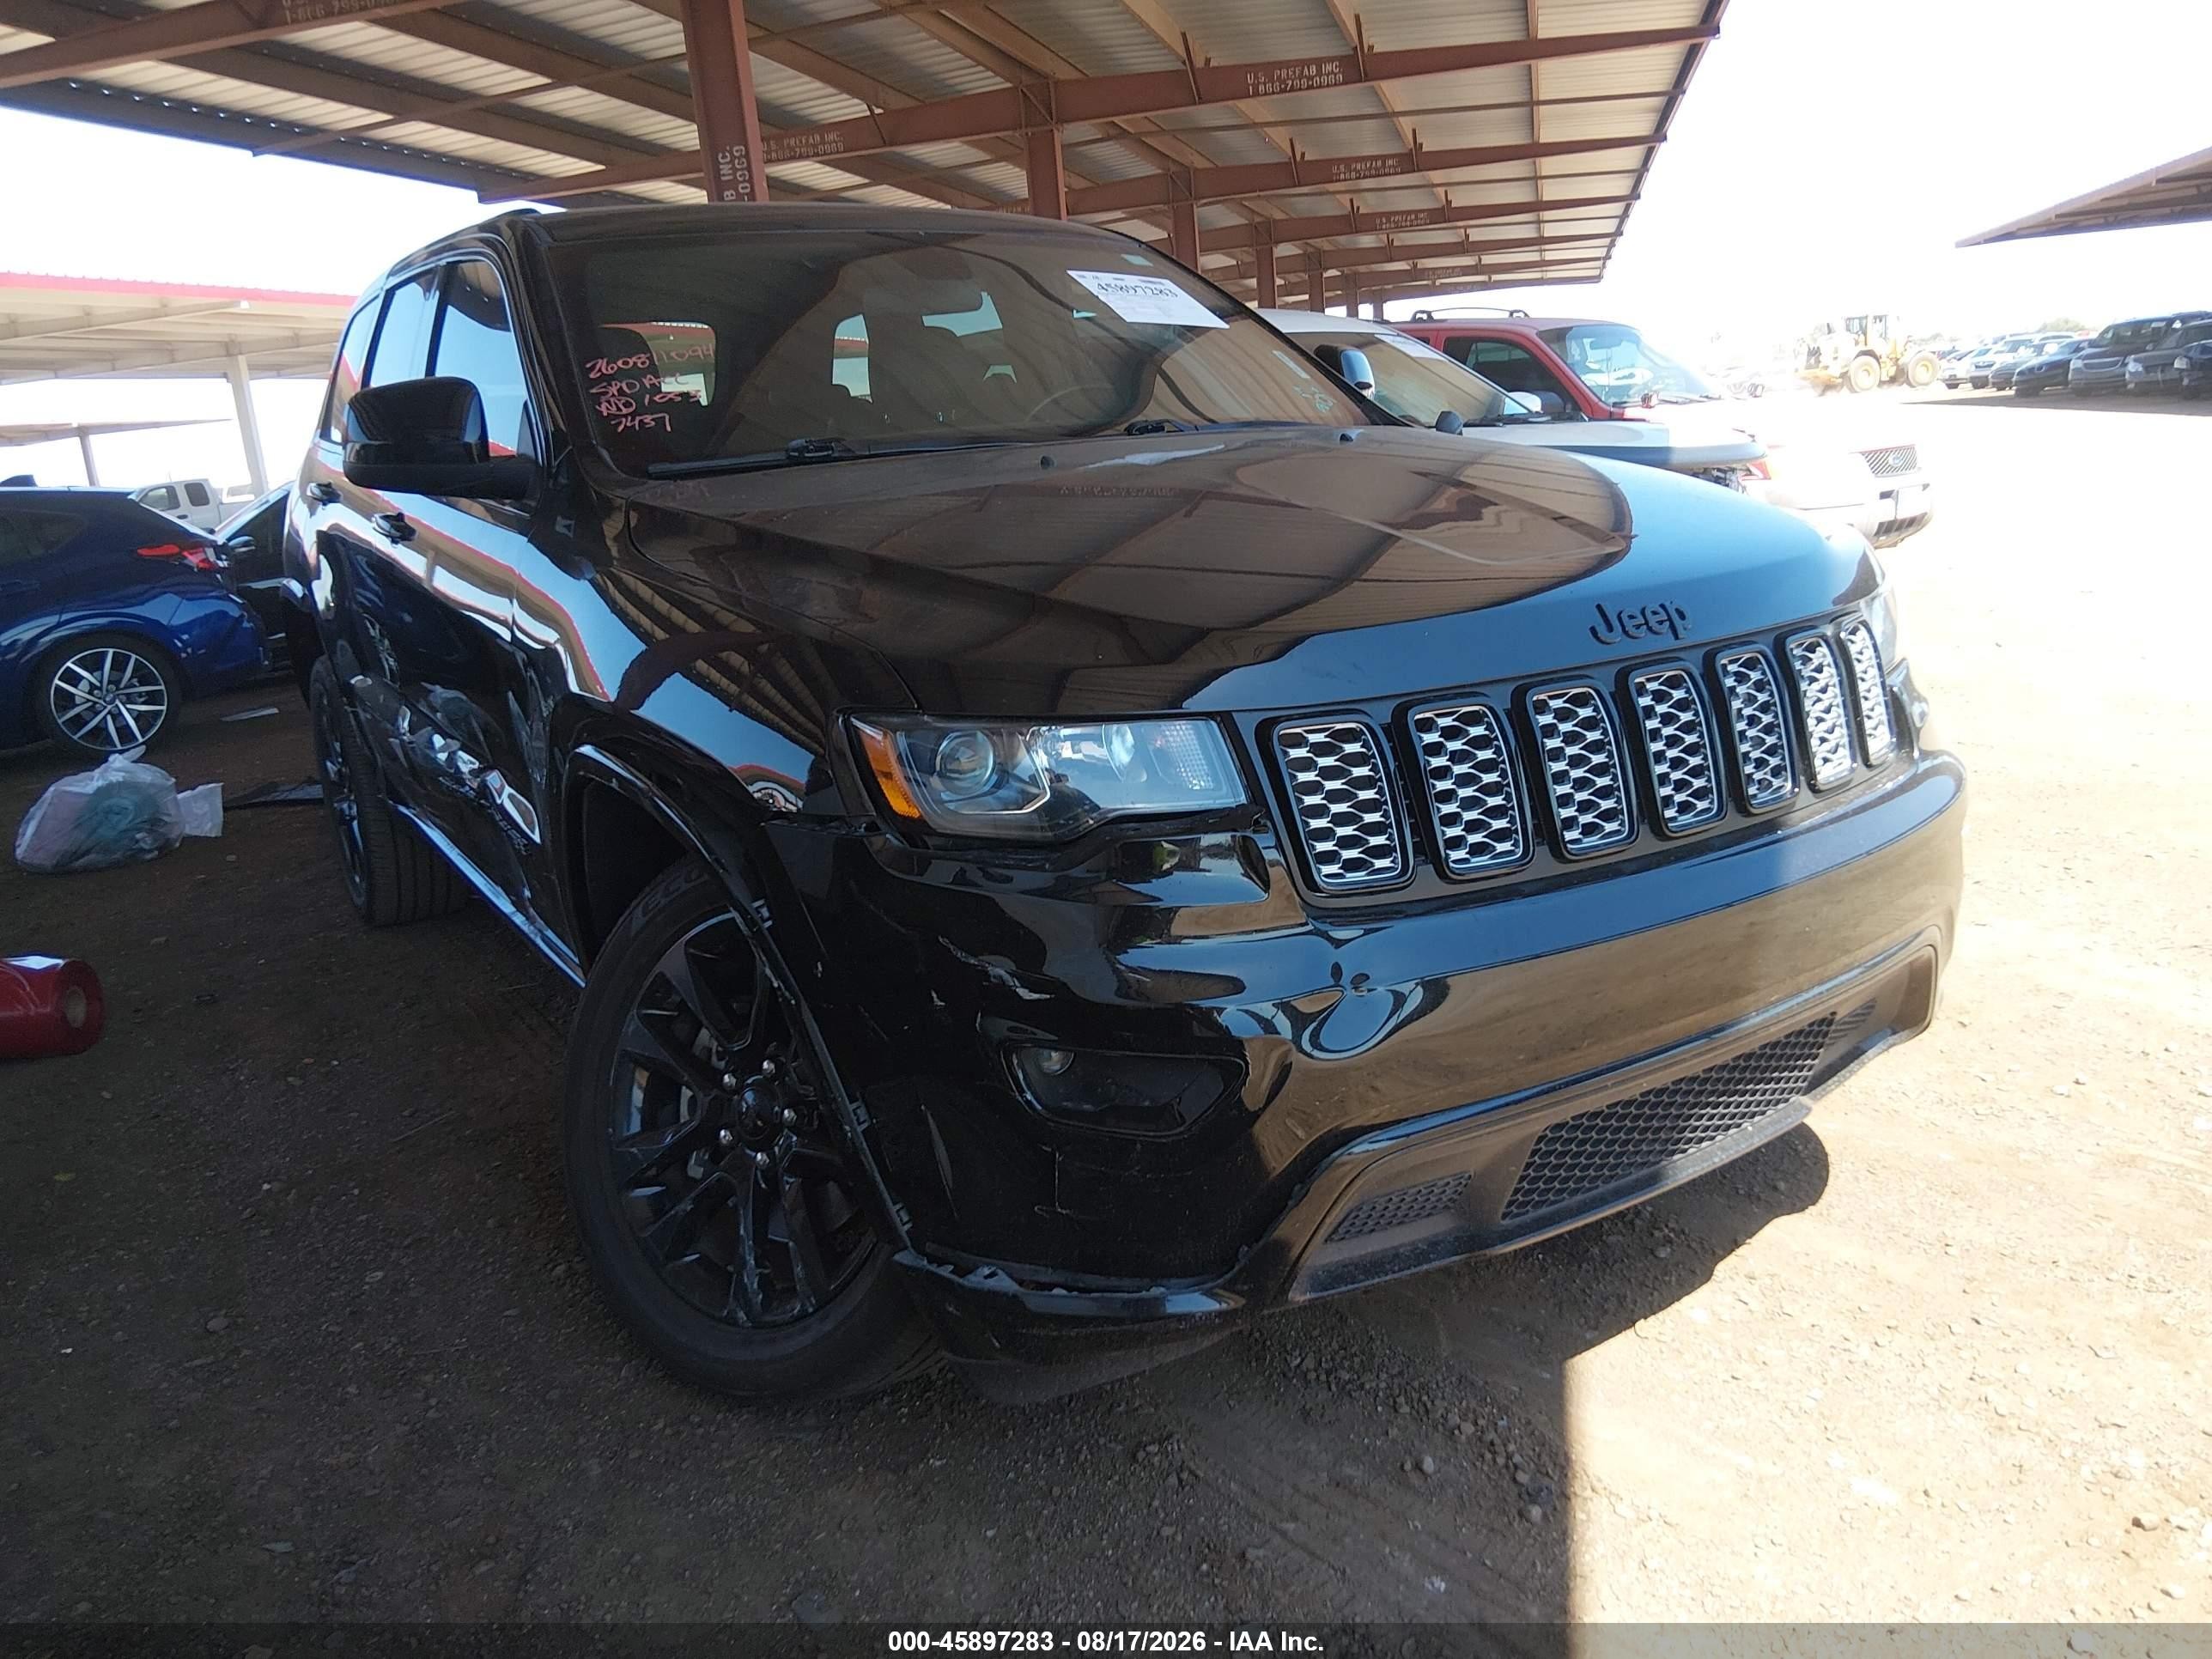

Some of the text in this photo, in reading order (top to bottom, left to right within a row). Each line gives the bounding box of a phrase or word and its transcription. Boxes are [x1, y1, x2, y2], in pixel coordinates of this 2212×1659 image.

[1273, 64, 1316, 81] PREFAB
[1322, 61, 1343, 74] INC.
[1097, 282, 1178, 298] 45897283
[1589, 602, 1692, 645] Jeep
